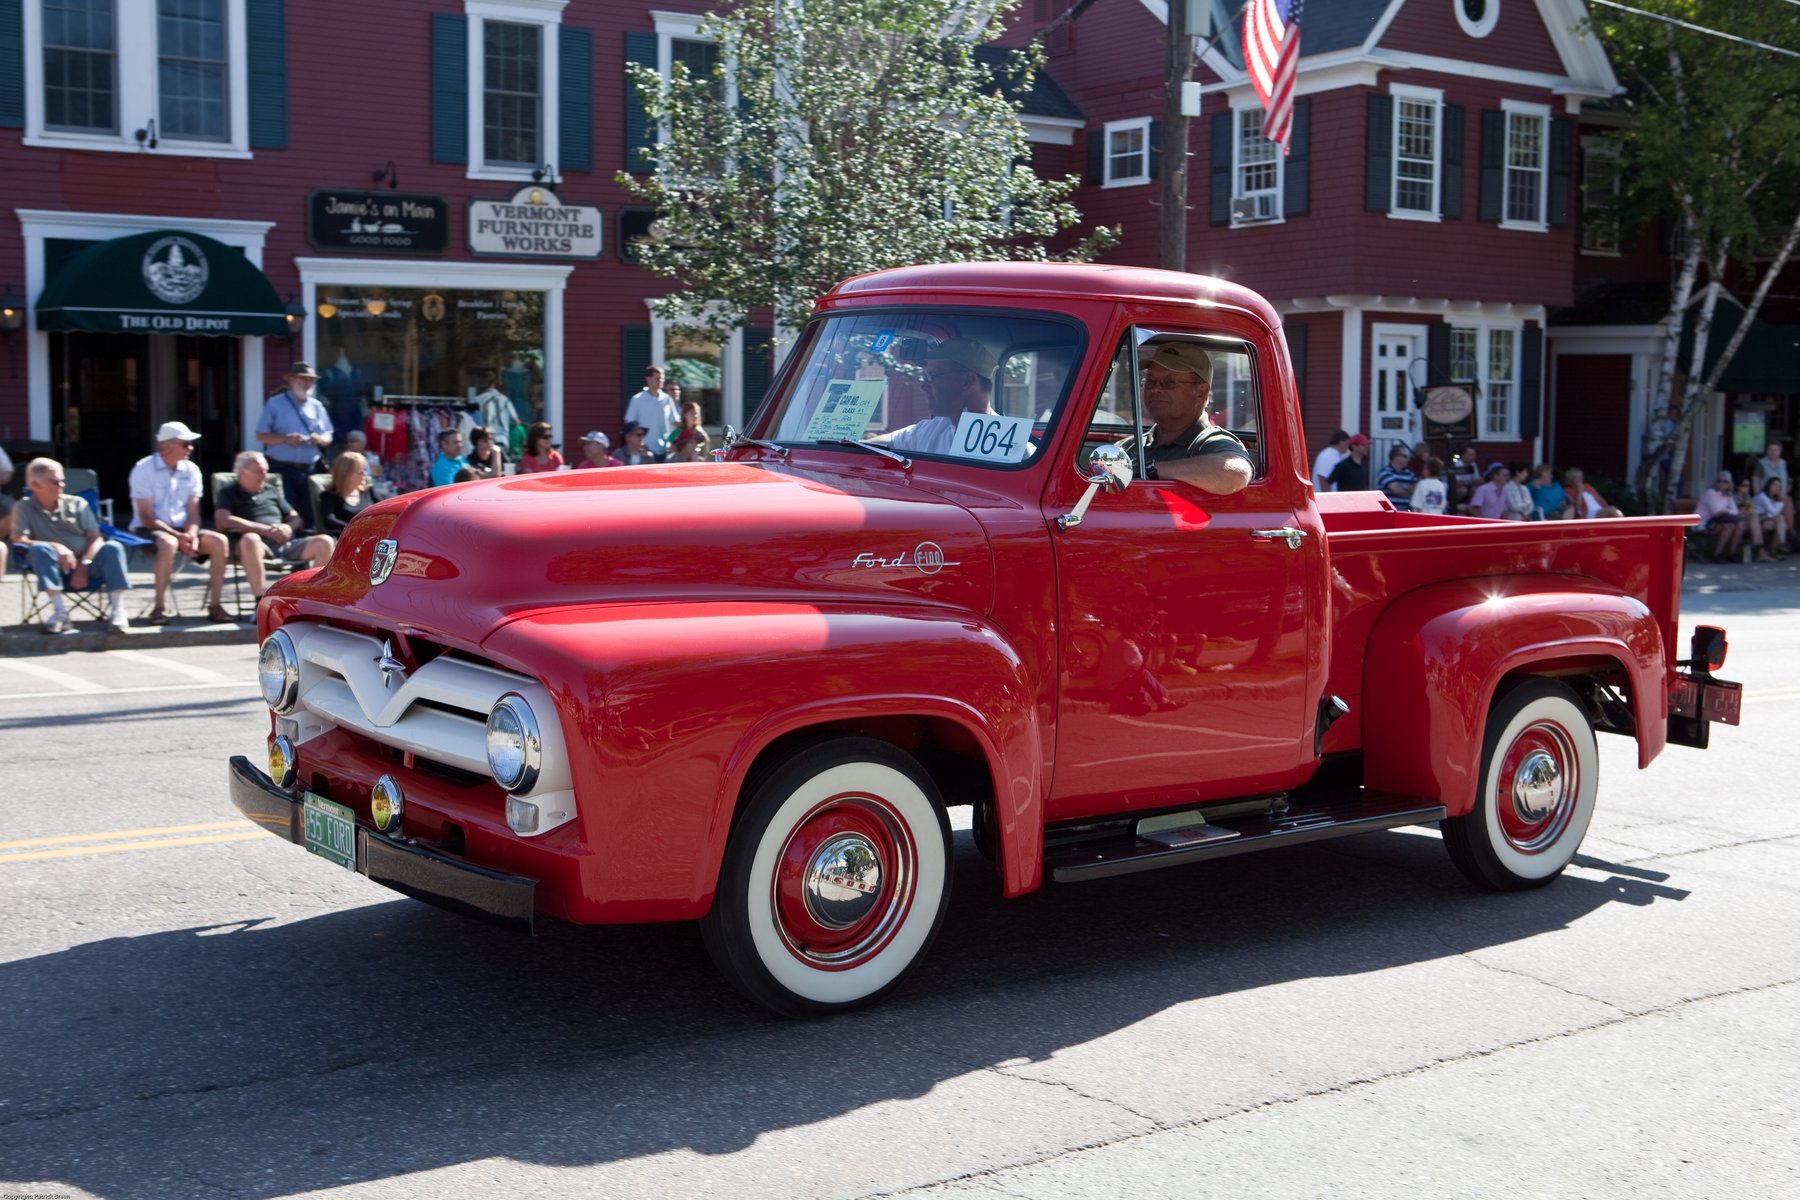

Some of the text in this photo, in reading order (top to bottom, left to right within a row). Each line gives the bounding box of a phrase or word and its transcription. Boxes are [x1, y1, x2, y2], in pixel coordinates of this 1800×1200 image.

[325, 197, 435, 218] Jamie's on Main
[491, 204, 582, 222] VERMONT
[477, 219, 594, 238] FURNITURE
[349, 236, 412, 246] GOOD FOOD
[501, 235, 572, 252] WORKS
[119, 314, 231, 330] THE OLD DEPOT
[964, 418, 1018, 457] 064
[851, 551, 941, 568] Ford F-100
[309, 810, 322, 841] 55
[327, 817, 352, 855] FORD
